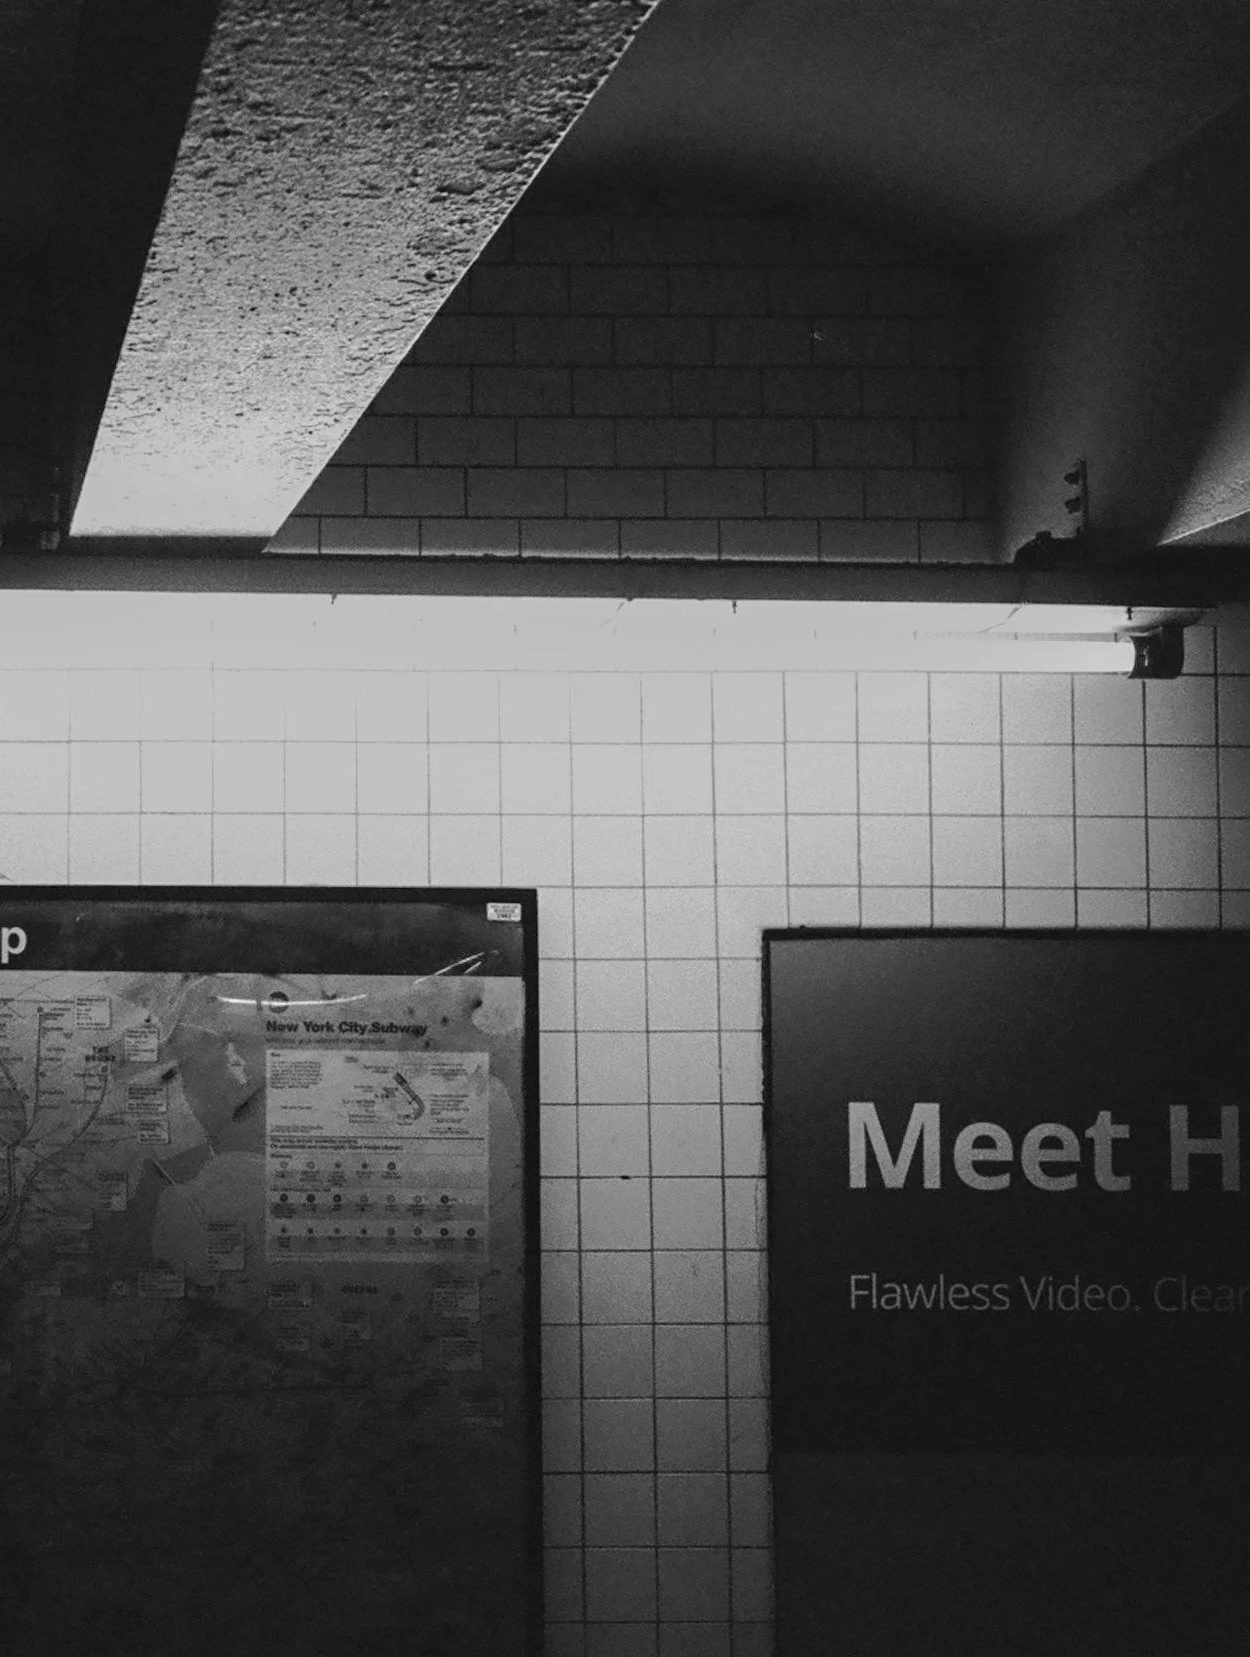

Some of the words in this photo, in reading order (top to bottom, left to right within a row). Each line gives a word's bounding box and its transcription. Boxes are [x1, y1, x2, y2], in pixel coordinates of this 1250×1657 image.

[266, 1020, 299, 1033] New
[303, 1020, 335, 1033] York
[338, 1020, 369, 1036] City
[370, 1021, 429, 1037] Subway
[847, 1101, 1132, 1192] Meet
[1168, 1104, 1241, 1192] H
[849, 1272, 1011, 1312] Flawless
[1019, 1274, 1141, 1313] Video.
